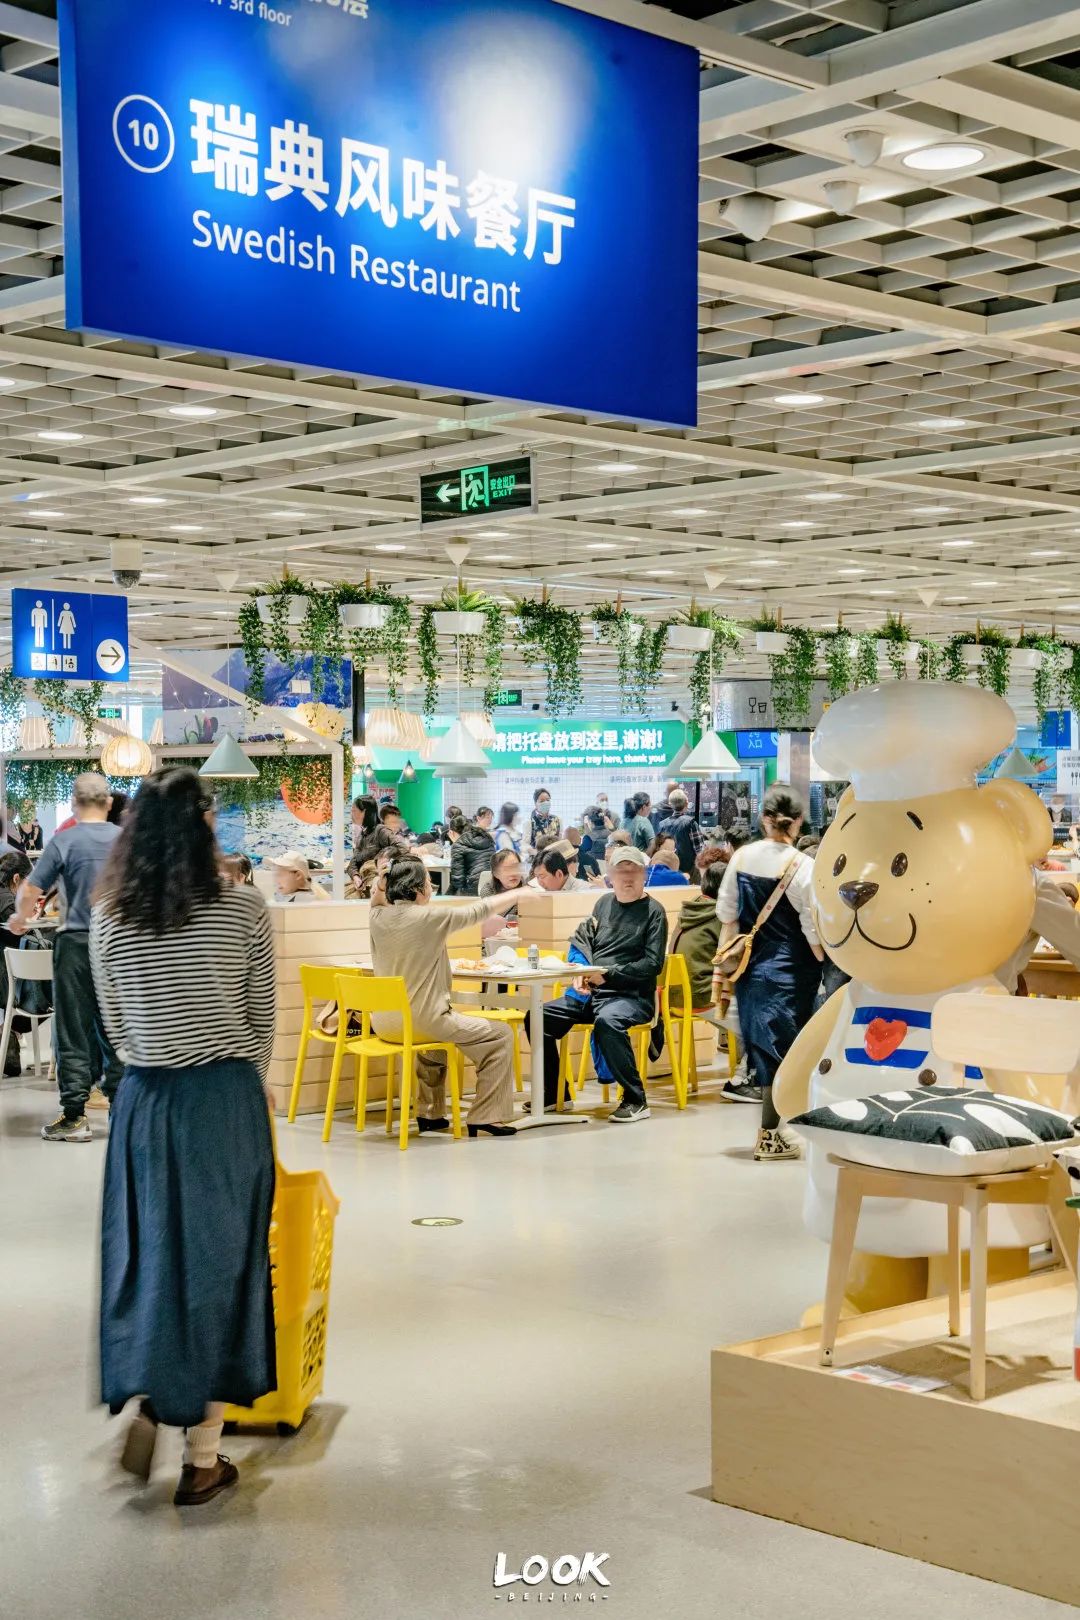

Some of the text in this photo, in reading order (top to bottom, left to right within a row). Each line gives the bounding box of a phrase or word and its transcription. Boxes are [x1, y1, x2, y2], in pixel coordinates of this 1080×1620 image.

[258, 2, 293, 27] floor
[127, 118, 159, 153] 10
[189, 98, 577, 266] 瑞典风味餐厅
[192, 209, 522, 314] Swedish Restaurant
[490, 475, 515, 490] 安全出口
[492, 488, 513, 498] EXIT
[521, 755, 545, 765] Please
[546, 755, 567, 764] leave
[567, 756, 585, 766] your
[585, 755, 602, 766] tray
[624, 754, 647, 764] thank
